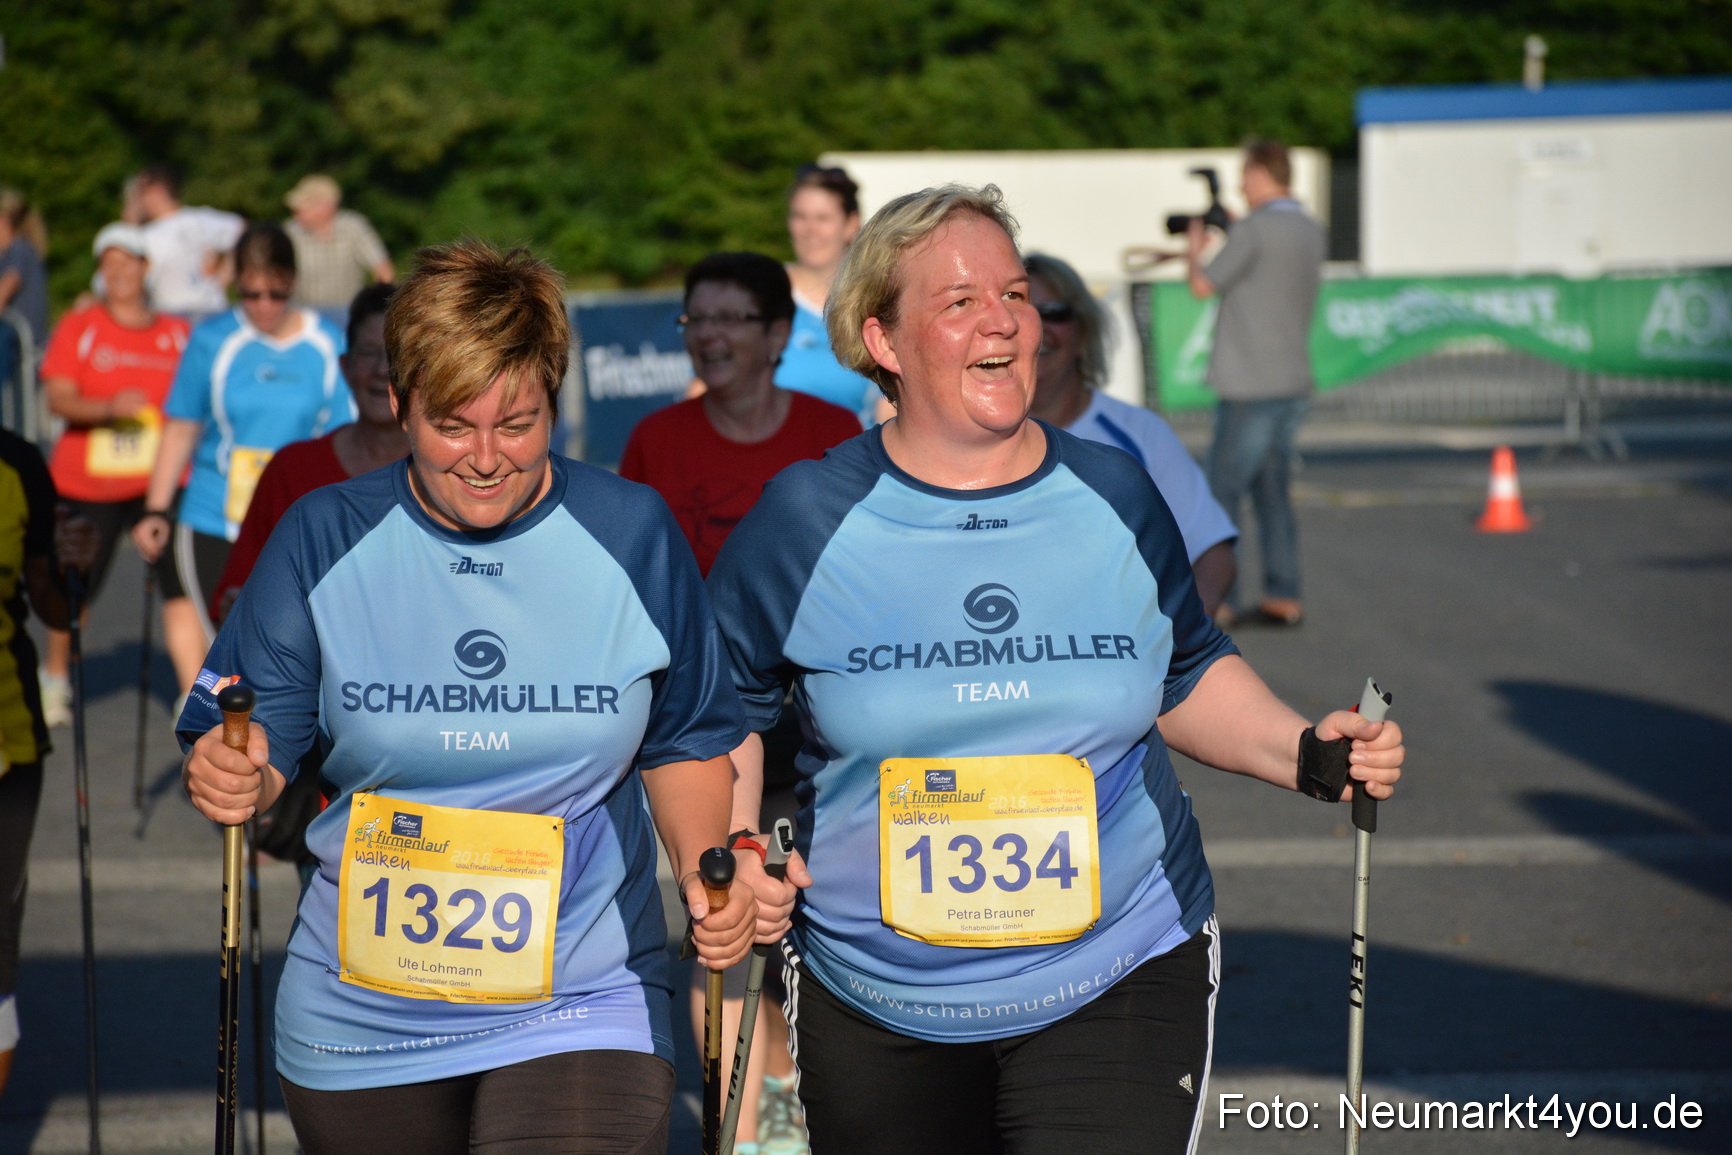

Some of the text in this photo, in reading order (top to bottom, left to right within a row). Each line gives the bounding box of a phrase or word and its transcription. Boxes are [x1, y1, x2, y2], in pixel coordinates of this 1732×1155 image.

[846, 634, 1139, 674] SCHABMÜLLER
[341, 681, 620, 715] SCHABMÜLLER
[953, 680, 1030, 703] TEAM
[440, 731, 510, 751] TEAM
[912, 788, 986, 803] firmenlauf
[988, 796, 1027, 809] 2016
[893, 810, 950, 826] walken
[376, 830, 450, 853] firmenlauf
[376, 845, 407, 853] neumarkt
[355, 850, 410, 871] walken
[450, 850, 491, 864] 2016
[905, 830, 1079, 894] 1334
[363, 877, 533, 953] 1329
[948, 908, 1035, 920] Petra Brauner
[1002, 923, 1023, 931] GmbH
[398, 957, 482, 977] Ute Lohmann
[1350, 930, 1364, 1010] LEKI
[407, 975, 471, 988] Schabmüller GmbH
[849, 951, 1135, 1019] www.schabmueller.de
